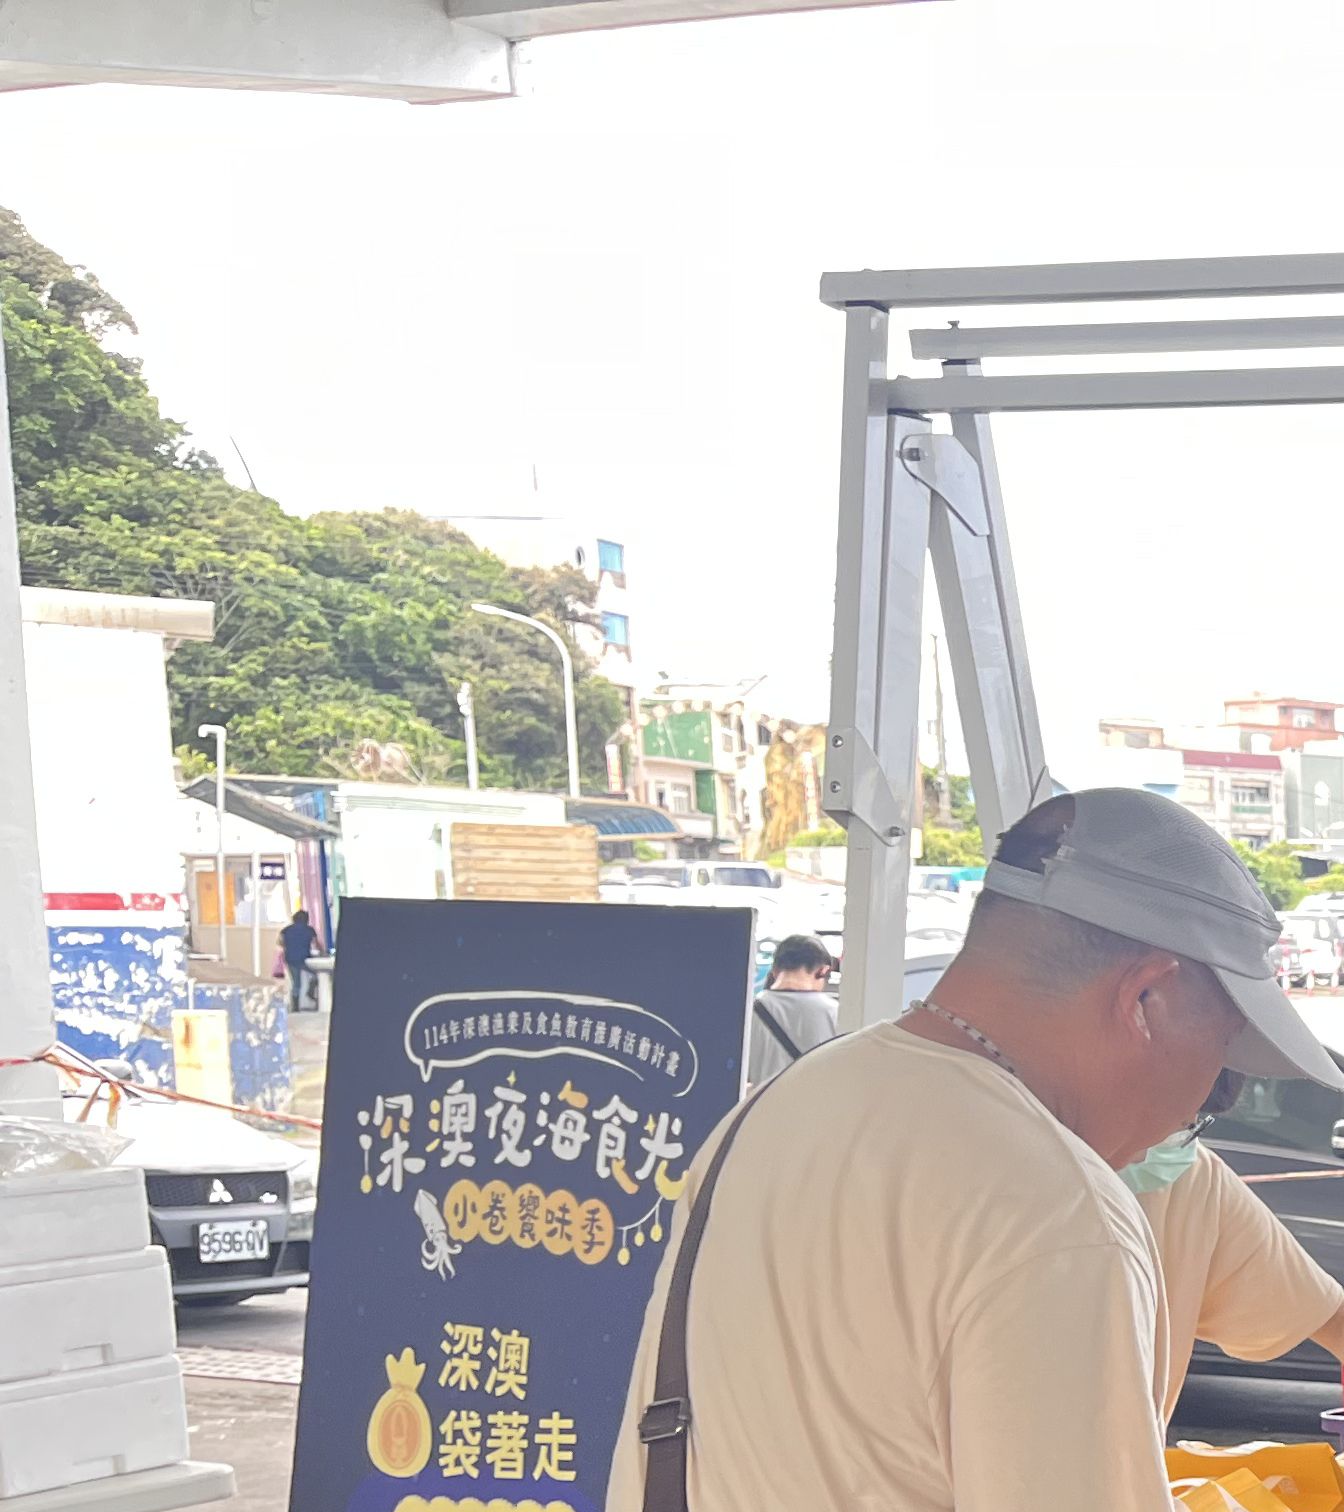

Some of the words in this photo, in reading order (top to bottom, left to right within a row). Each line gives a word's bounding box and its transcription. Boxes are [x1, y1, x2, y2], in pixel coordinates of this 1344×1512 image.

[357, 1079, 690, 1195] 深澳夜海食光
[438, 1321, 531, 1400] 深澳
[438, 1410, 577, 1482] 袋著走
